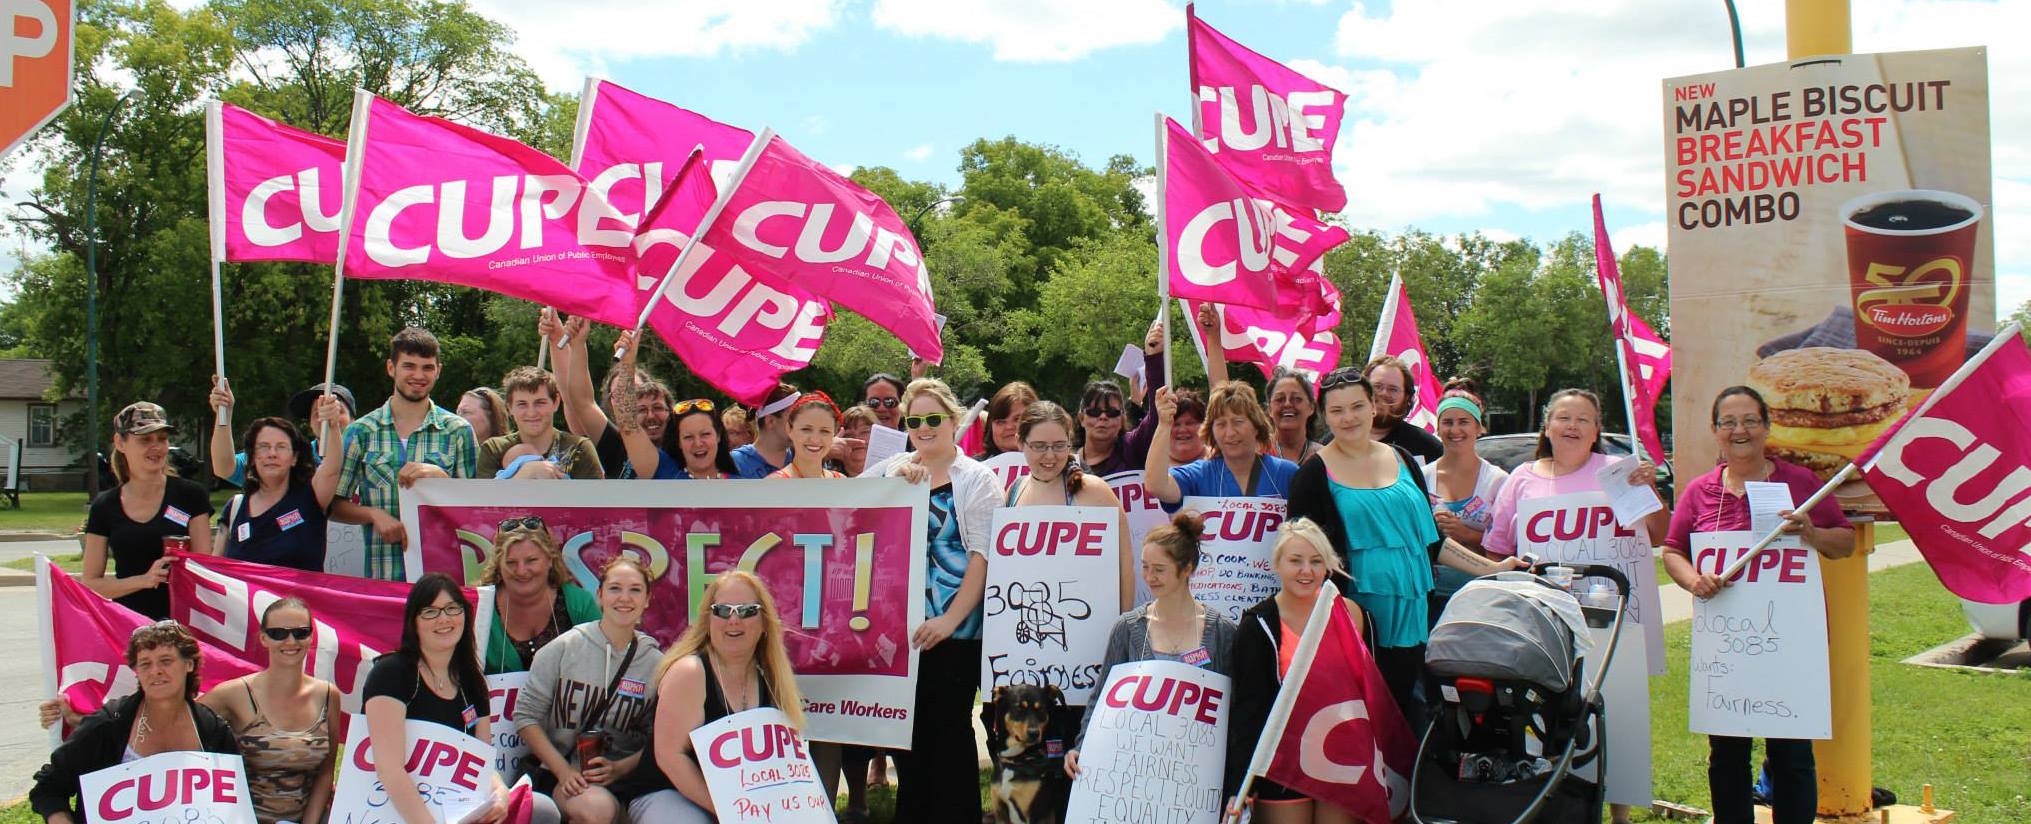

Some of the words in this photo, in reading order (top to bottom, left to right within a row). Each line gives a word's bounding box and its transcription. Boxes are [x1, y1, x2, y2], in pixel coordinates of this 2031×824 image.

[1675, 83, 1716, 102] NEW
[1676, 91, 1792, 134] MAPLE
[1802, 80, 1951, 118] BISCUIT
[1676, 117, 1887, 167] BREAKFAST
[1676, 152, 1867, 198] SANDWICH
[363, 174, 636, 269] CUPE
[1678, 191, 1800, 231] COMBO
[488, 256, 531, 270] Canadian
[532, 252, 557, 264] Union
[557, 251, 566, 260] of
[567, 250, 590, 260] Public
[633, 228, 828, 363] CUPE
[1872, 308, 1896, 325] Tim
[1896, 311, 1948, 326] Hortons
[995, 521, 1108, 557] CUPE
[1199, 510, 1284, 543] CUP
[1252, 558, 1271, 572] WE
[1718, 633, 1781, 656] 3085
[552, 677, 607, 731] NEW
[840, 699, 908, 720] Workers
[1105, 675, 1224, 726] CUPE
[708, 723, 807, 769] CUPE
[1099, 709, 1166, 738] LOCAL
[1175, 716, 1217, 748] 3085
[1116, 732, 1145, 753] WE
[1150, 739, 1198, 761] WANT
[740, 769, 784, 788] LOCAL
[1113, 750, 1199, 785] FAIRNESS
[98, 768, 238, 822] CUPE
[733, 797, 773, 823] PAY
[1097, 793, 1197, 824] EQUALITY
